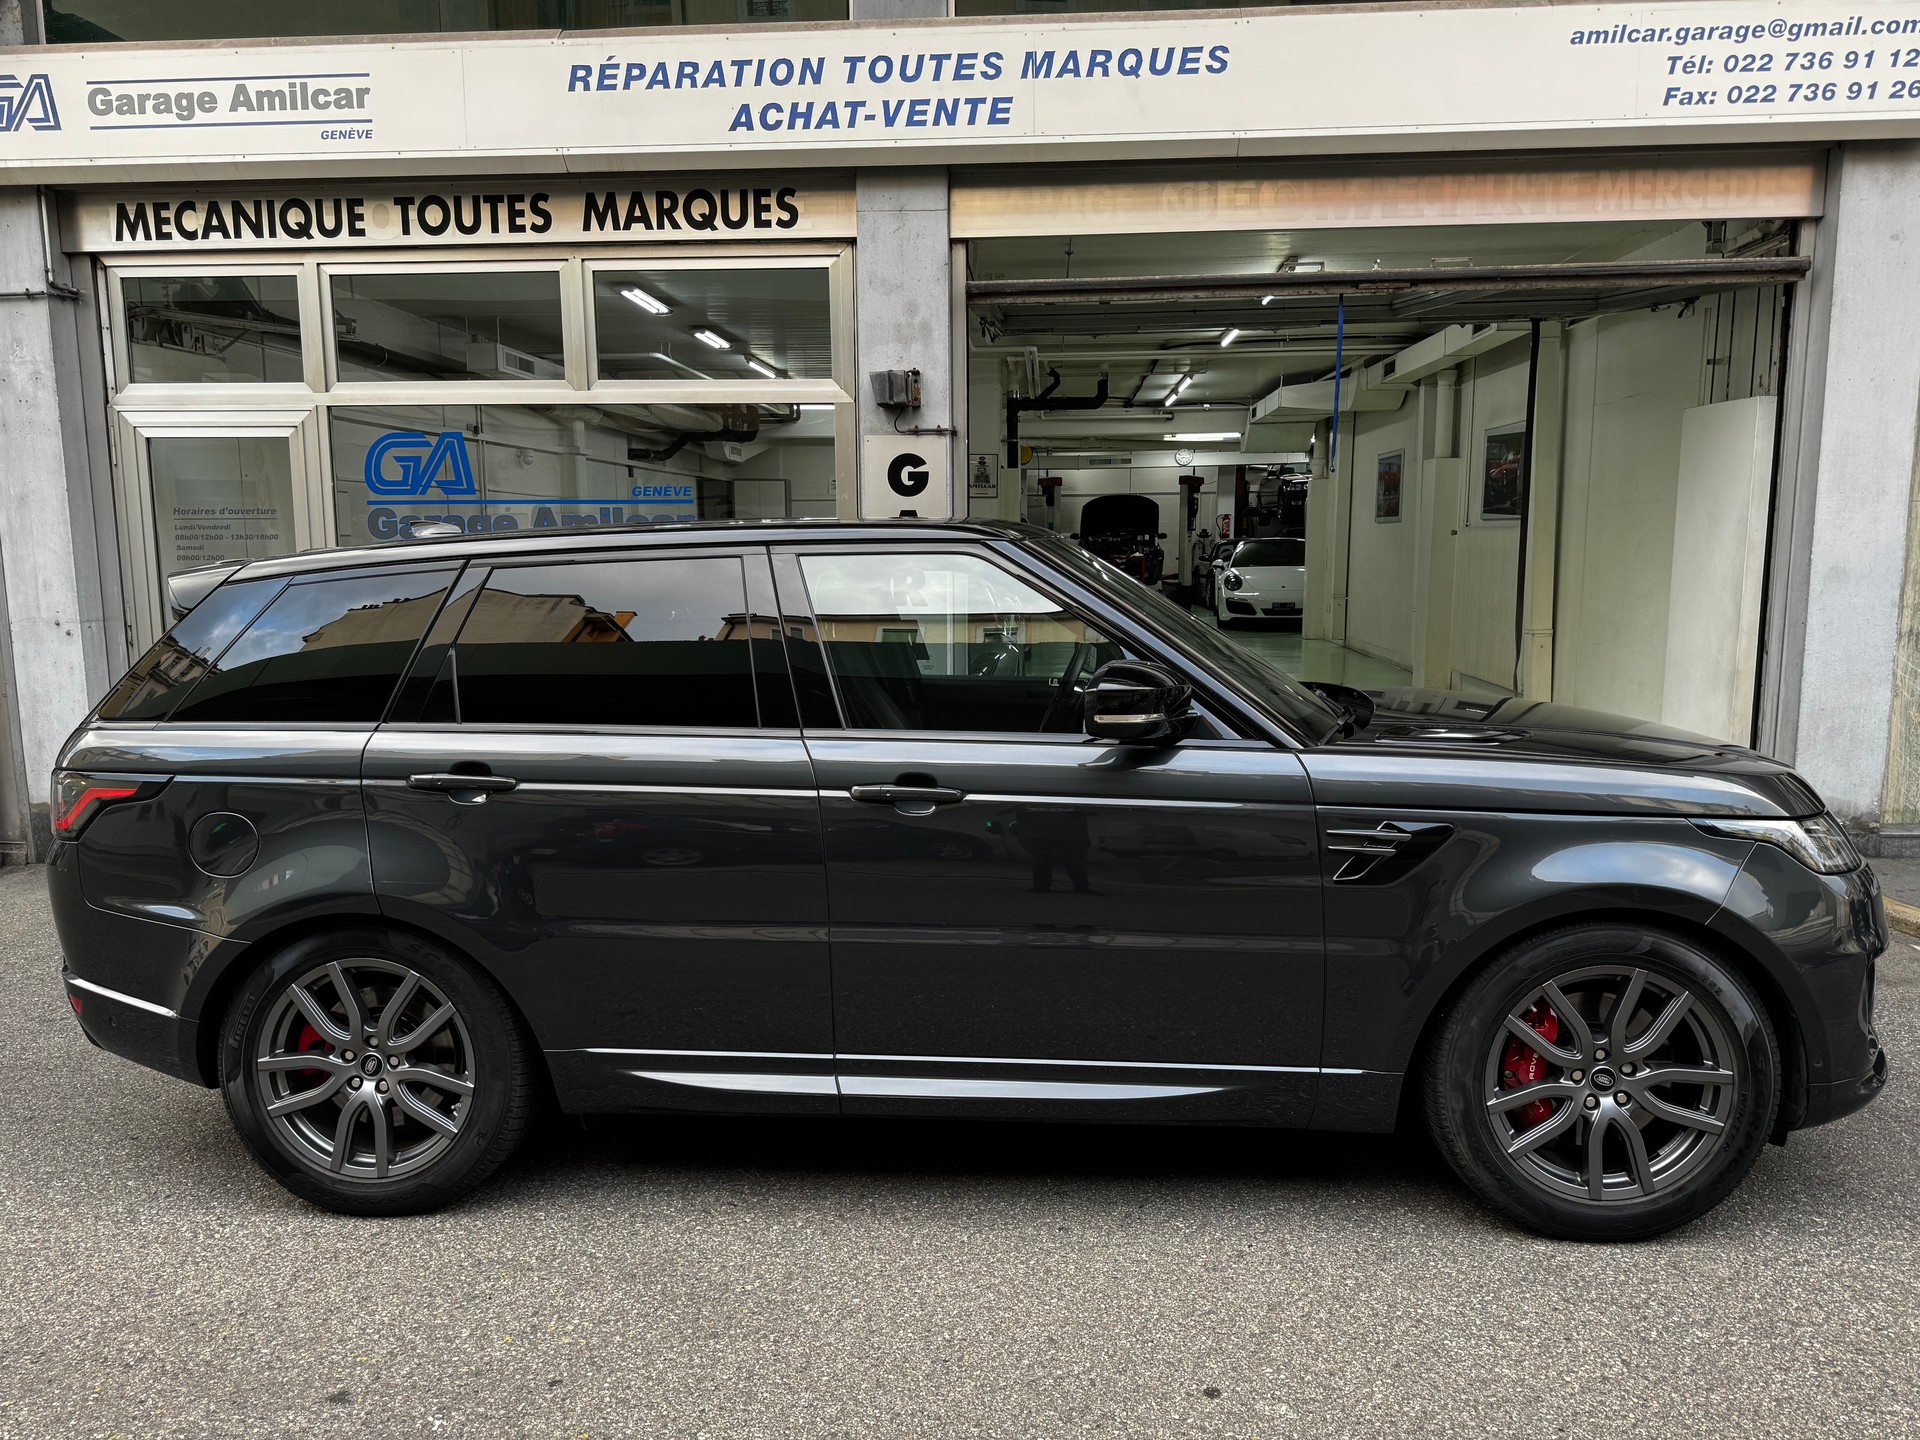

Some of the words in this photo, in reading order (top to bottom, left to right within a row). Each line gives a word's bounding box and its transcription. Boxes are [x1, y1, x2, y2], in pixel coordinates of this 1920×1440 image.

[1570, 16, 1920, 46] amilcar.garage@gmail.com
[568, 55, 825, 92] RÉPARATION
[844, 51, 1003, 85] TOUTES
[1020, 45, 1230, 80] MARQUES
[1666, 54, 1714, 75] Tél:
[1723, 53, 1774, 73] 022
[1784, 52, 1833, 71] 736
[1843, 50, 1875, 69] 91
[1890, 48, 1920, 68] 12
[87, 86, 218, 121] Garage
[228, 81, 371, 113] Amilcar
[1662, 86, 1718, 106] Fax:
[1727, 85, 1778, 104] 022
[1788, 83, 1838, 102] 736
[1846, 81, 1879, 100] 91
[1888, 80, 1920, 99] 26
[728, 96, 1014, 132] ACHAT-VENTE
[320, 127, 373, 140] GENÈVE
[115, 198, 366, 242] MECANIQUE
[394, 193, 553, 236] TOUTES
[583, 187, 799, 232] MARQUES
[364, 431, 477, 496] GA
[887, 453, 930, 497] G
[631, 484, 694, 497] GENÈVE
[173, 507, 216, 516] Horaires
[218, 506, 277, 516] d'ouverture
[174, 523, 232, 531] Lundi/Vendredi
[1529, 1052, 1539, 1080] ROVE
